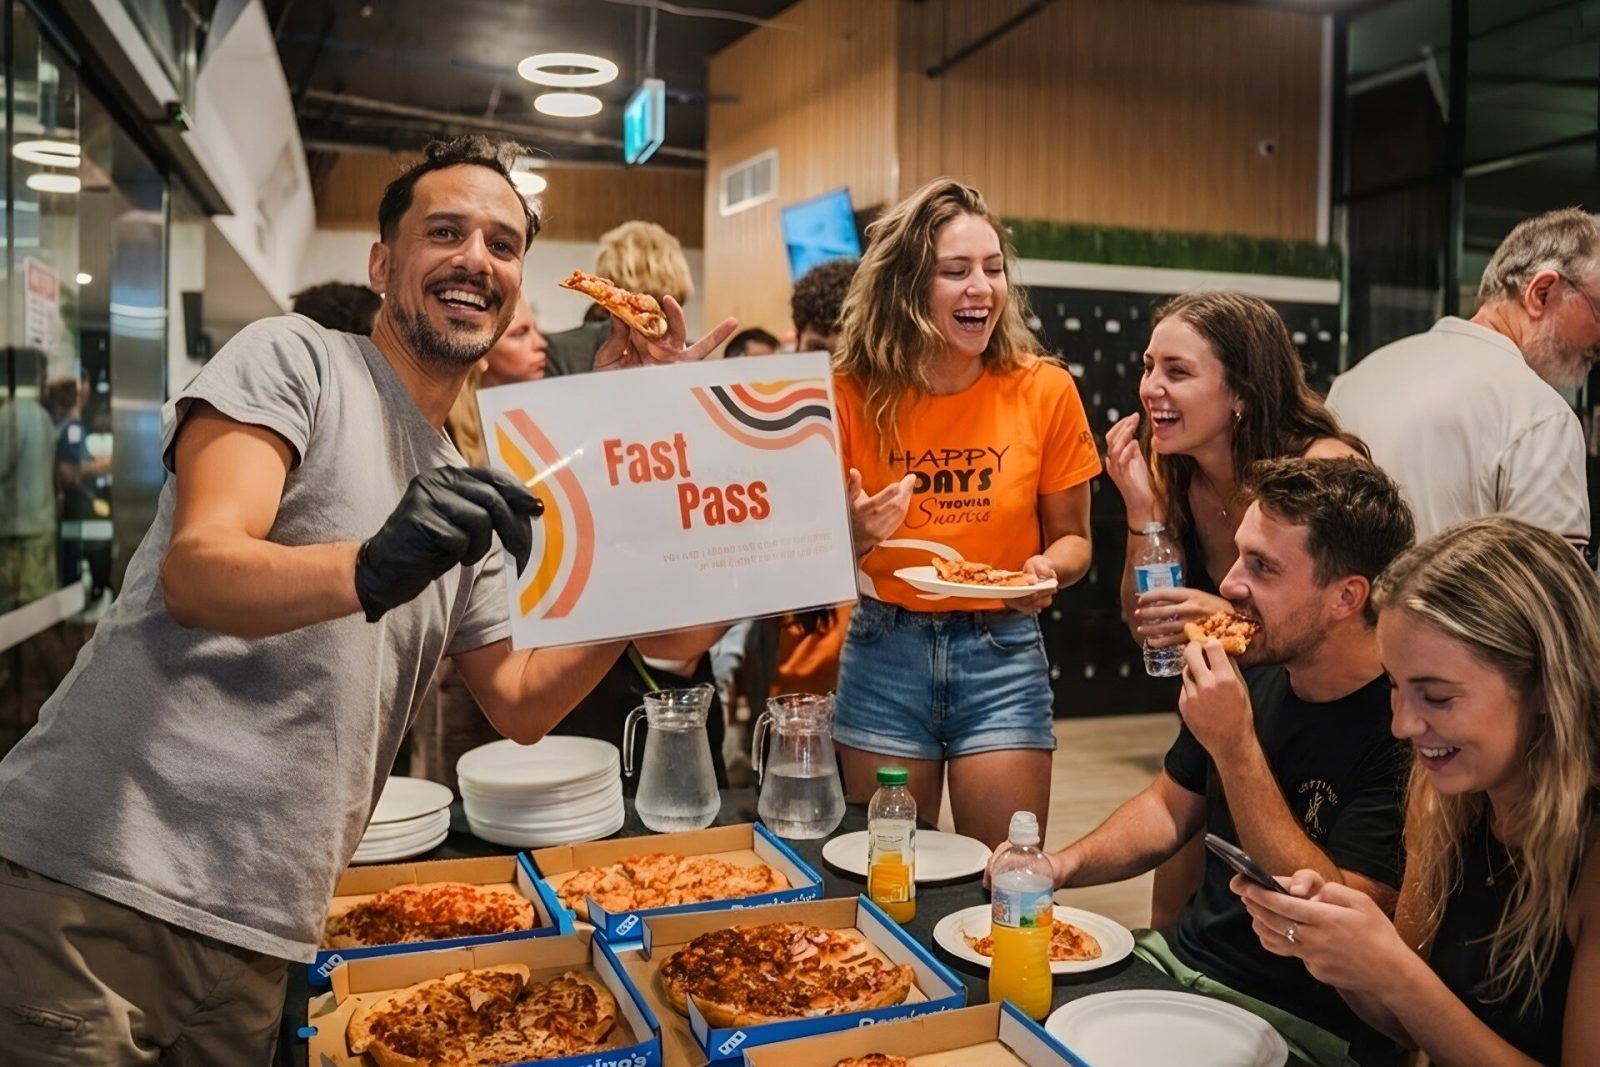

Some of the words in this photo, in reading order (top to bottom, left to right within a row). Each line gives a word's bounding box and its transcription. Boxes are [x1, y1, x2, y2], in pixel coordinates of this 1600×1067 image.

[603, 432, 692, 487] Fast
[889, 445, 1010, 474] HAPPY
[904, 467, 994, 495] DAYS
[677, 480, 771, 530] Pass
